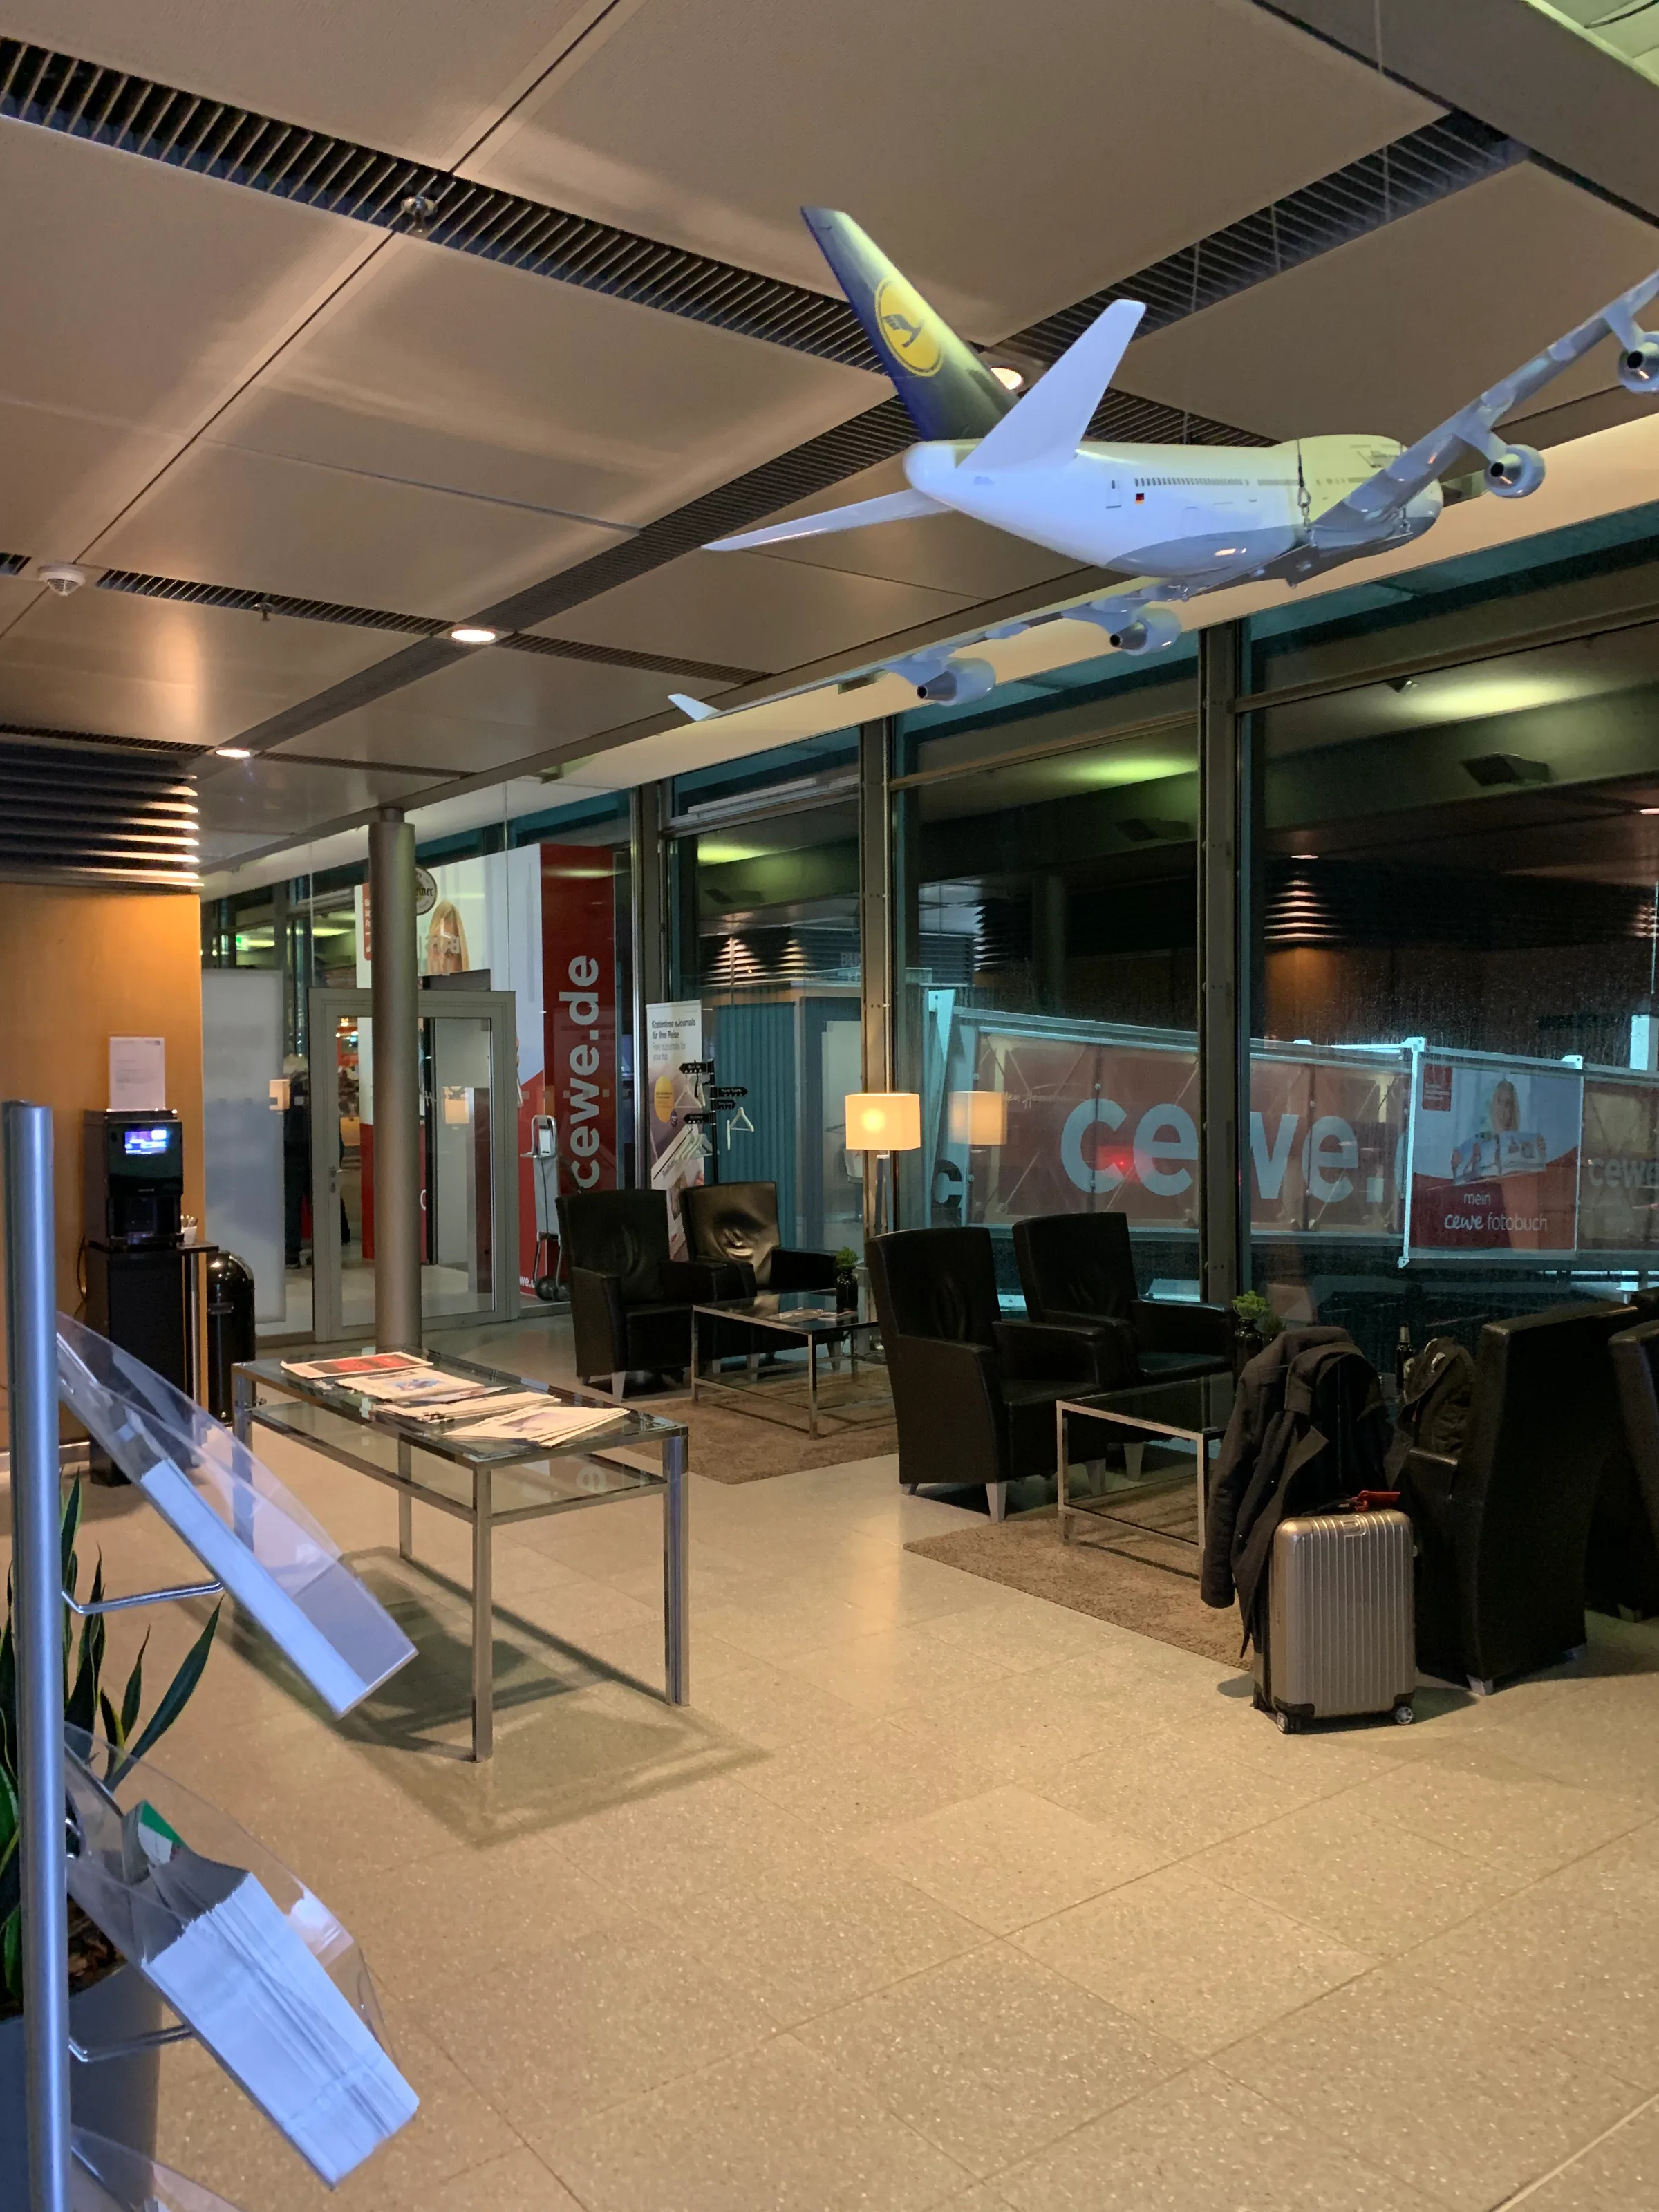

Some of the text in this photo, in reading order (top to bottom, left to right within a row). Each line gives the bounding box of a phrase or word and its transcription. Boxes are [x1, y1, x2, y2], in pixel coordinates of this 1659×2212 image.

[559, 955, 600, 1188] cewe.de
[1463, 1192, 1491, 1206] mein
[1444, 1212, 1548, 1231] cewe fotobuch
